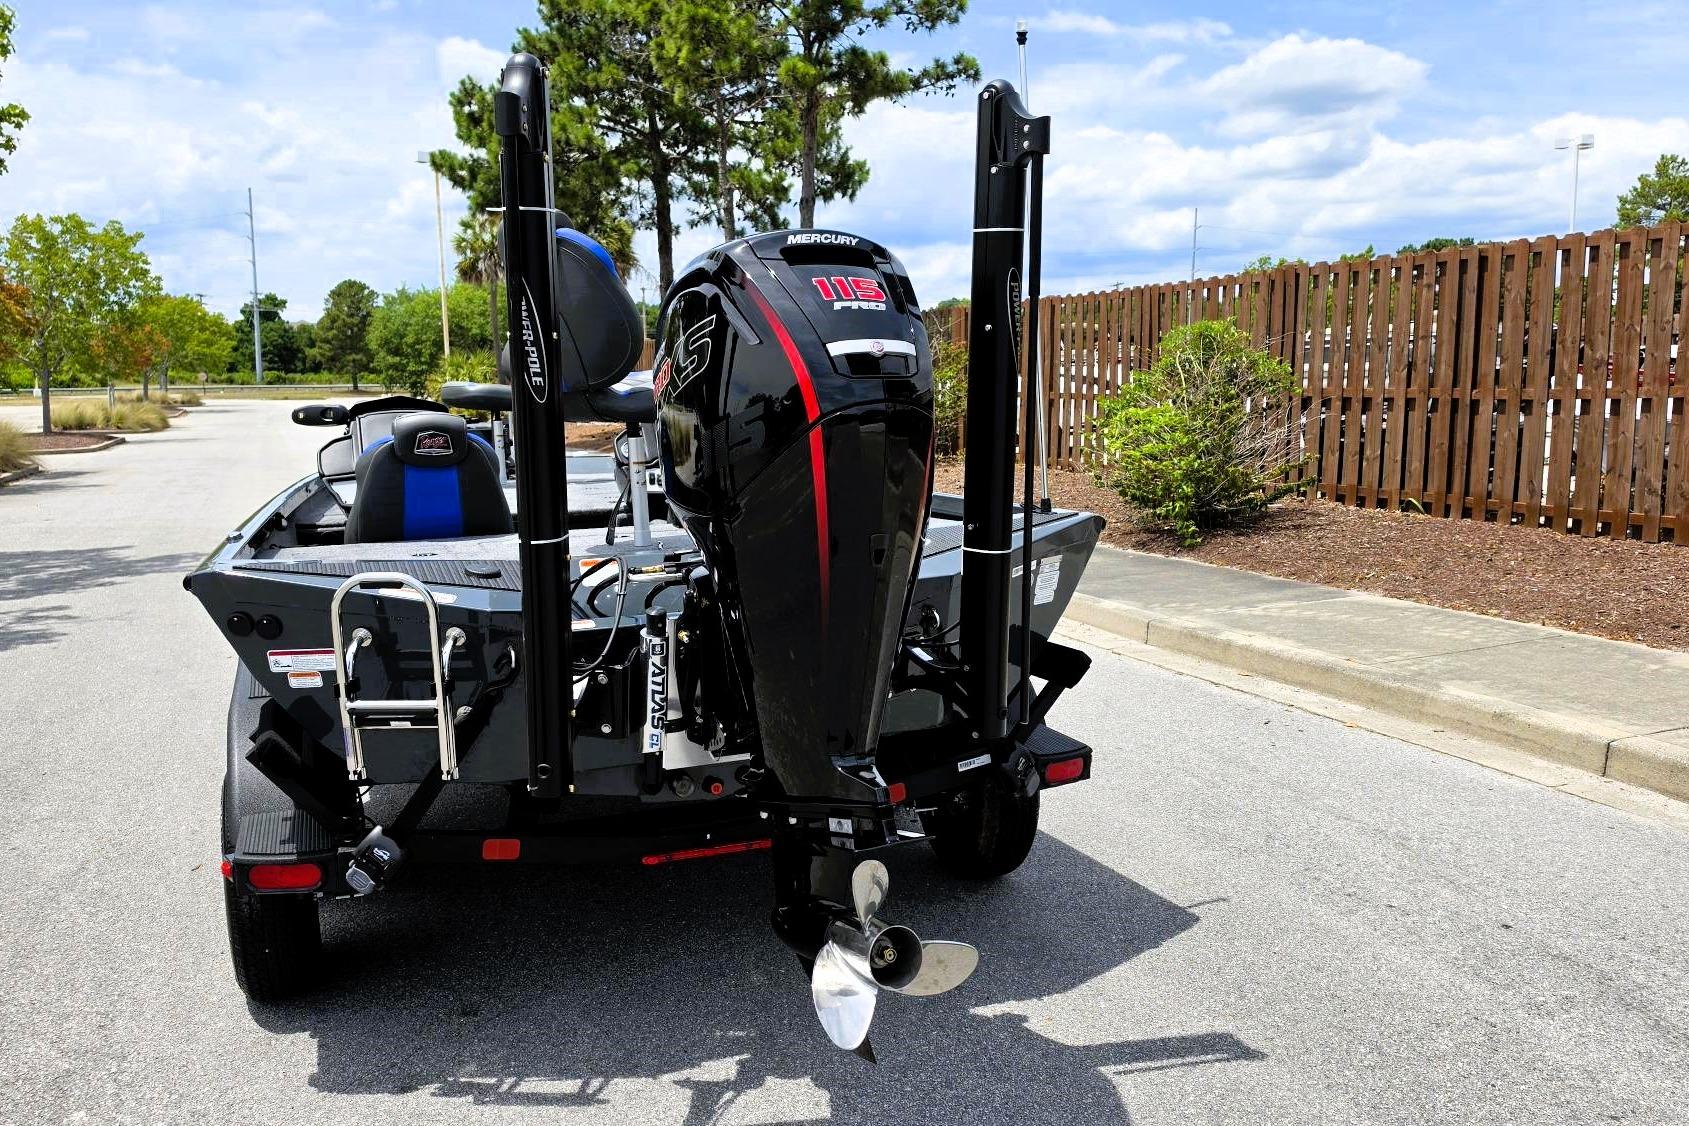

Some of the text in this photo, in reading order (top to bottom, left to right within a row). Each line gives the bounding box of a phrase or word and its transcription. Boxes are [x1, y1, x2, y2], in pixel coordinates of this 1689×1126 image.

[787, 233, 859, 246] MERCURY
[812, 276, 887, 301] 115
[833, 300, 887, 311] PRO
[1010, 281, 1022, 361] POWER-
[649, 660, 666, 749] ATLAS CL
